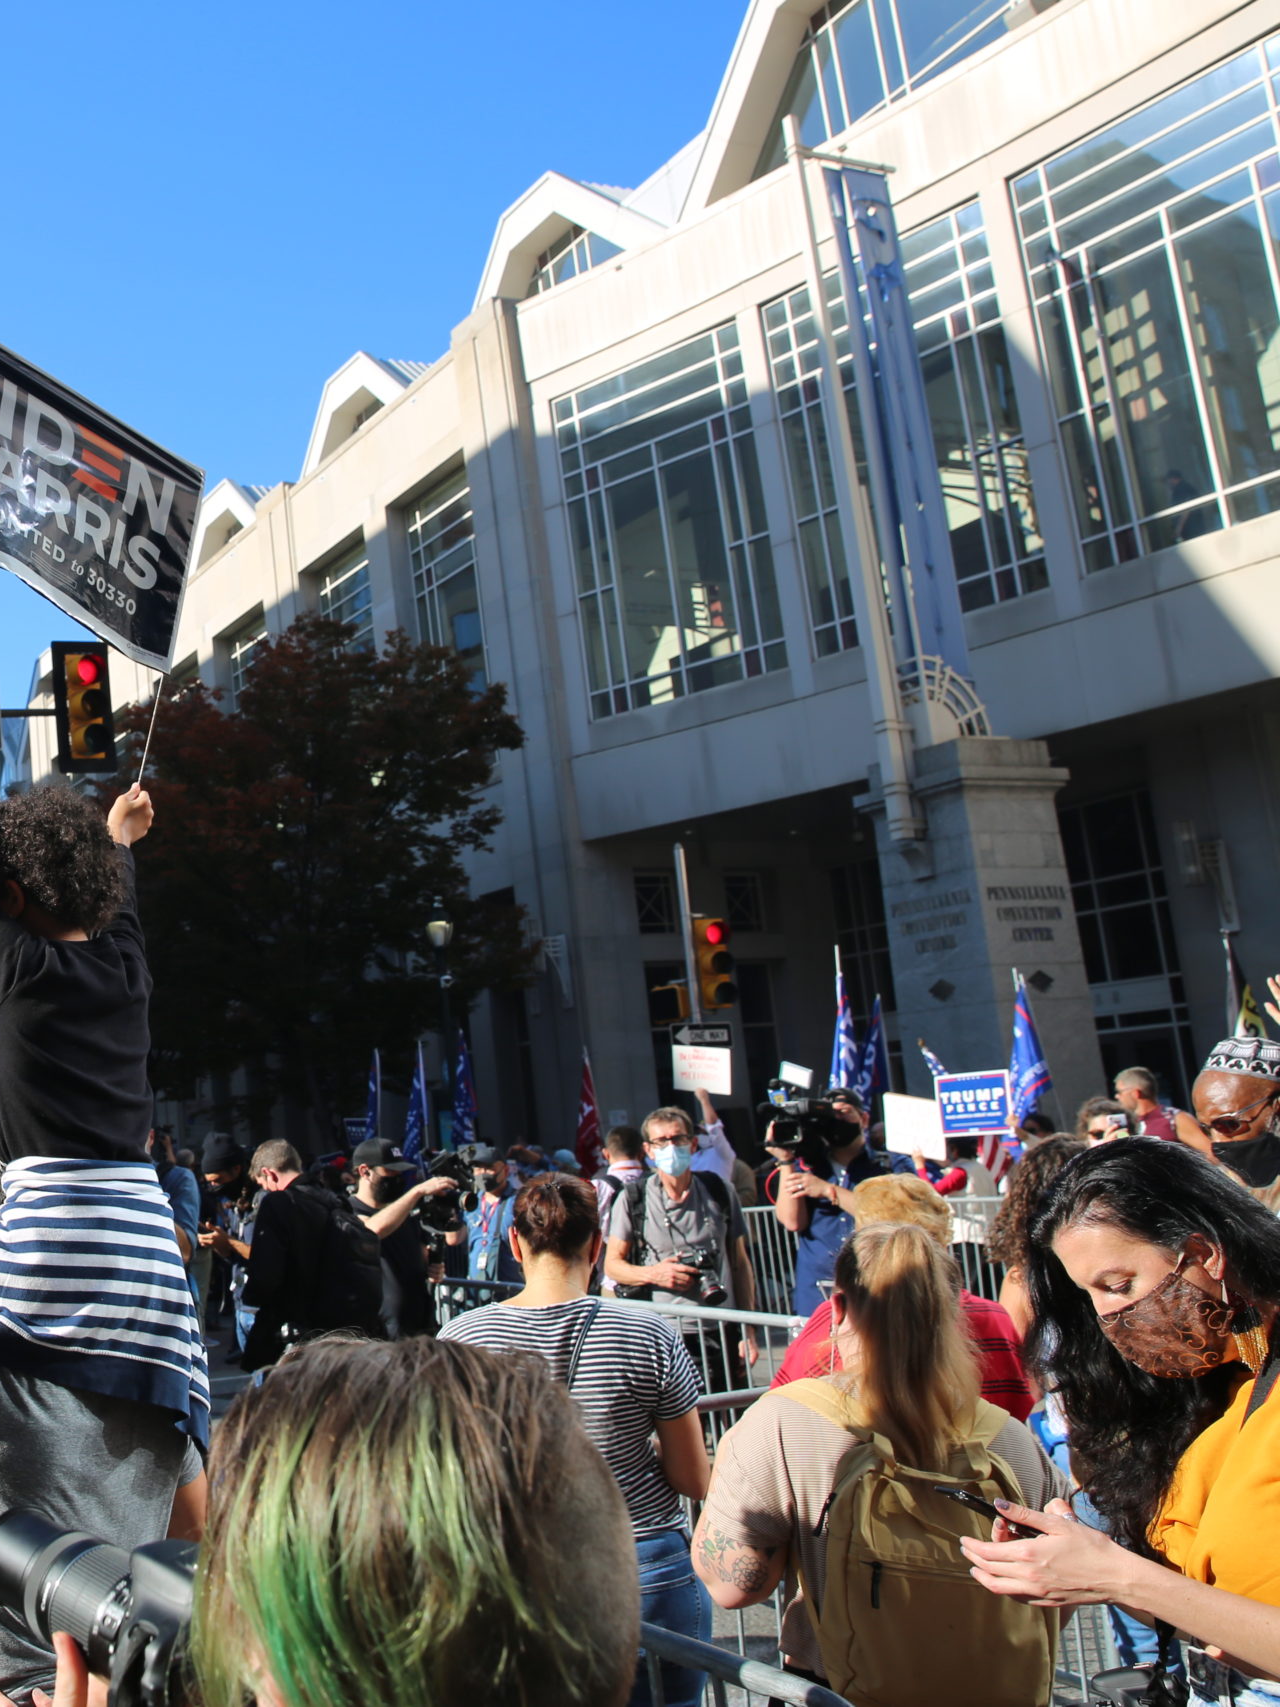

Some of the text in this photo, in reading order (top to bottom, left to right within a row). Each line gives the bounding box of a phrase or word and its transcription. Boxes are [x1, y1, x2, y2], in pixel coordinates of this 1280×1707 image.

[71, 559, 85, 576] to
[87, 567, 137, 616] 30330
[940, 1087, 1005, 1105] TRUMP
[945, 1101, 1000, 1114] PENCE
